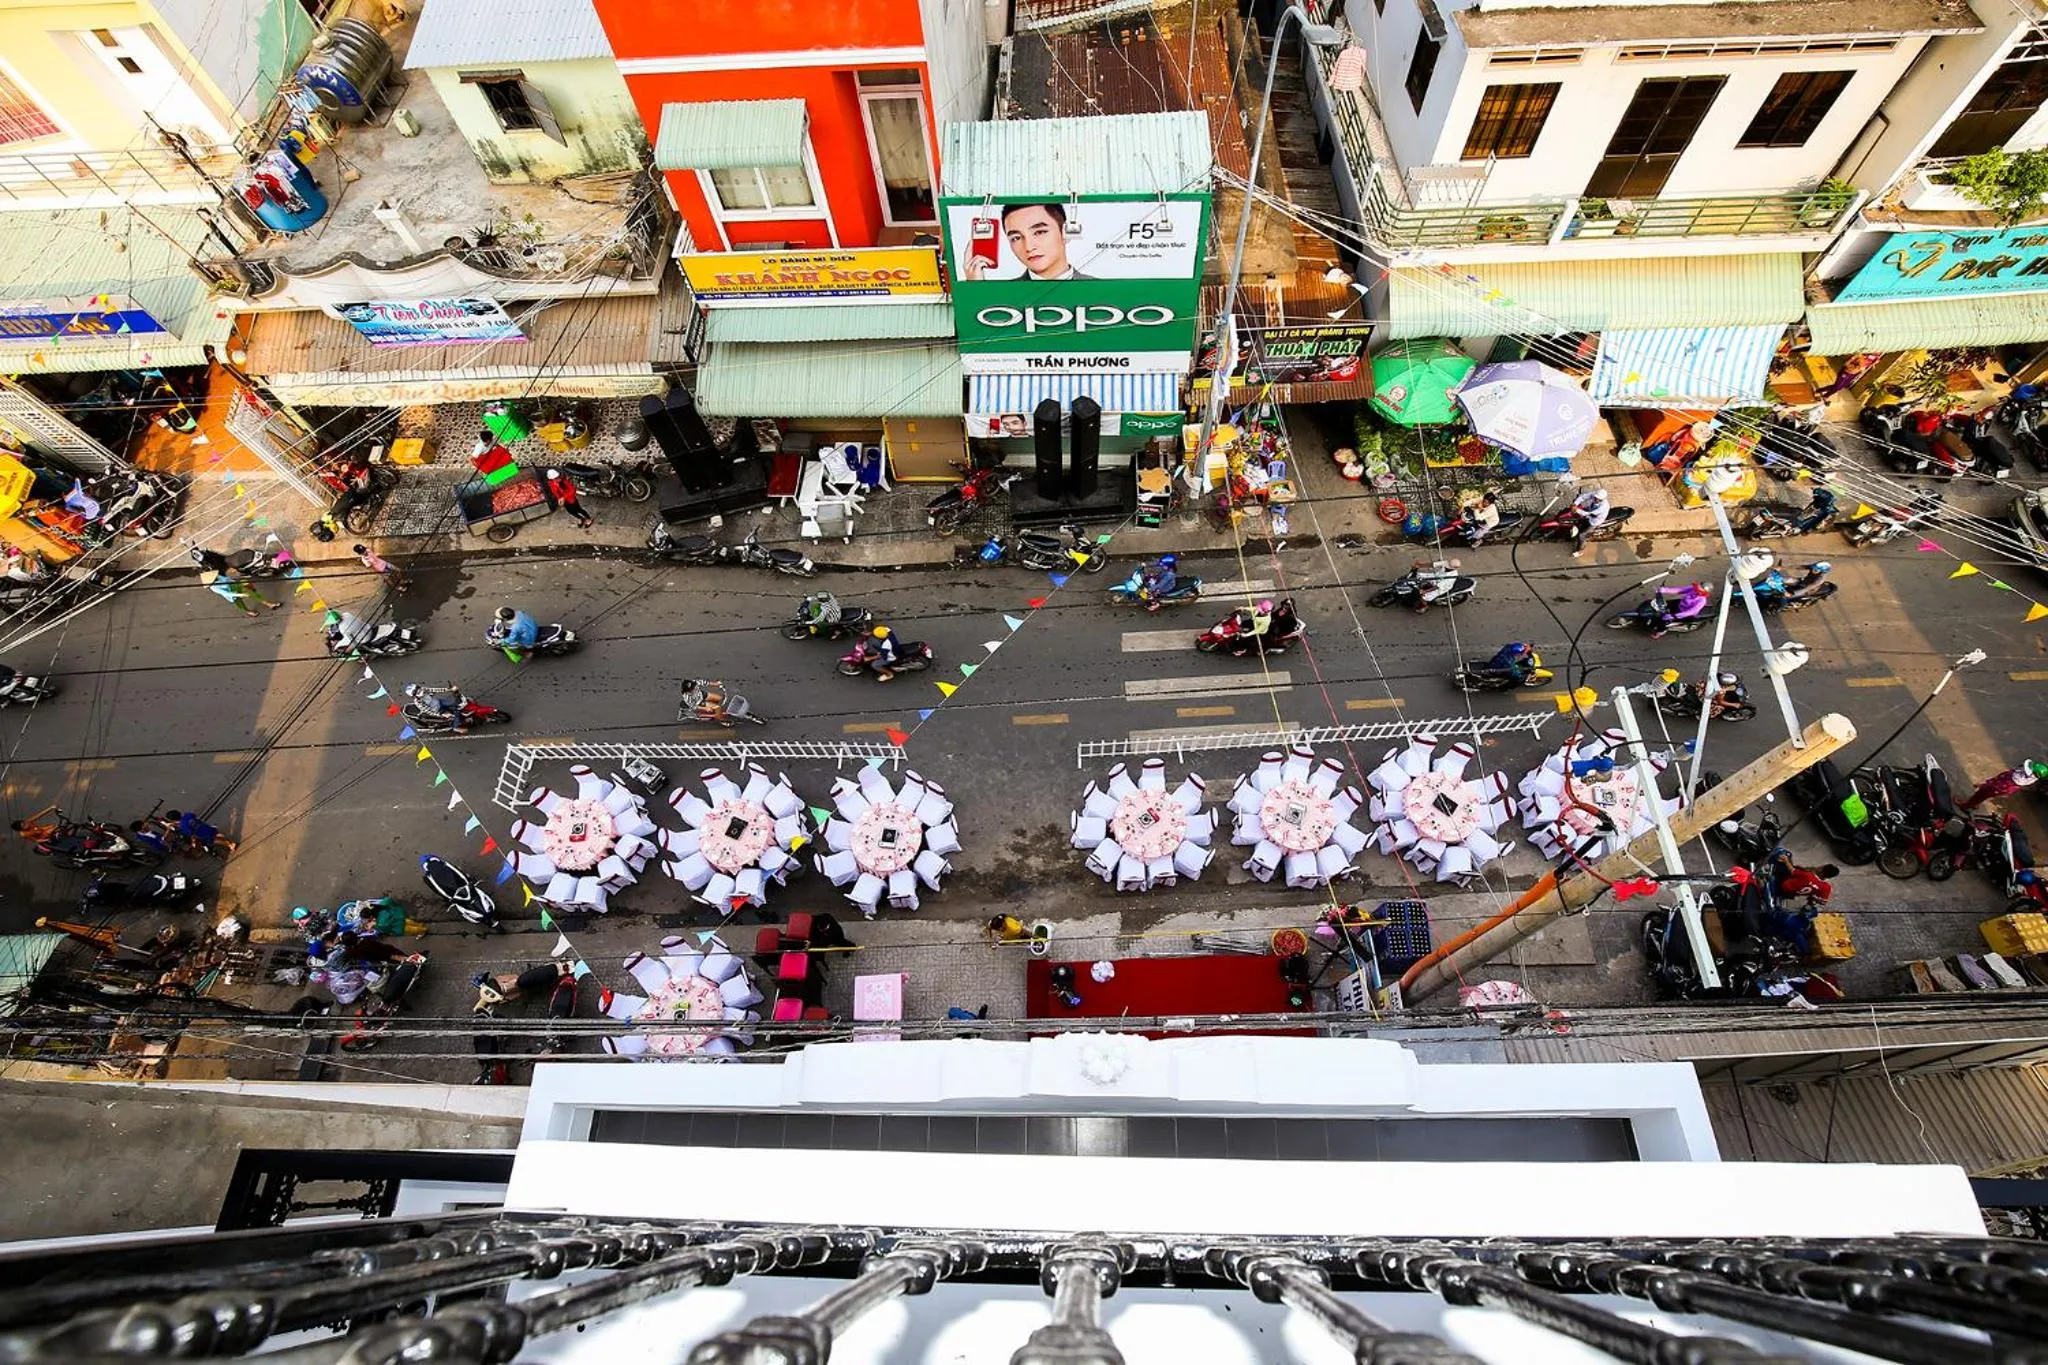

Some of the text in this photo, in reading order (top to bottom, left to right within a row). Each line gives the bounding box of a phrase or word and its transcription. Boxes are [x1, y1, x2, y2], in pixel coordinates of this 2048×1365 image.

[1129, 223, 1154, 239] F5
[714, 268, 911, 286] KHÁNH NGỌC
[1265, 339, 1318, 359] THUẬN
[1068, 356, 1130, 368] PHƯƠNG
